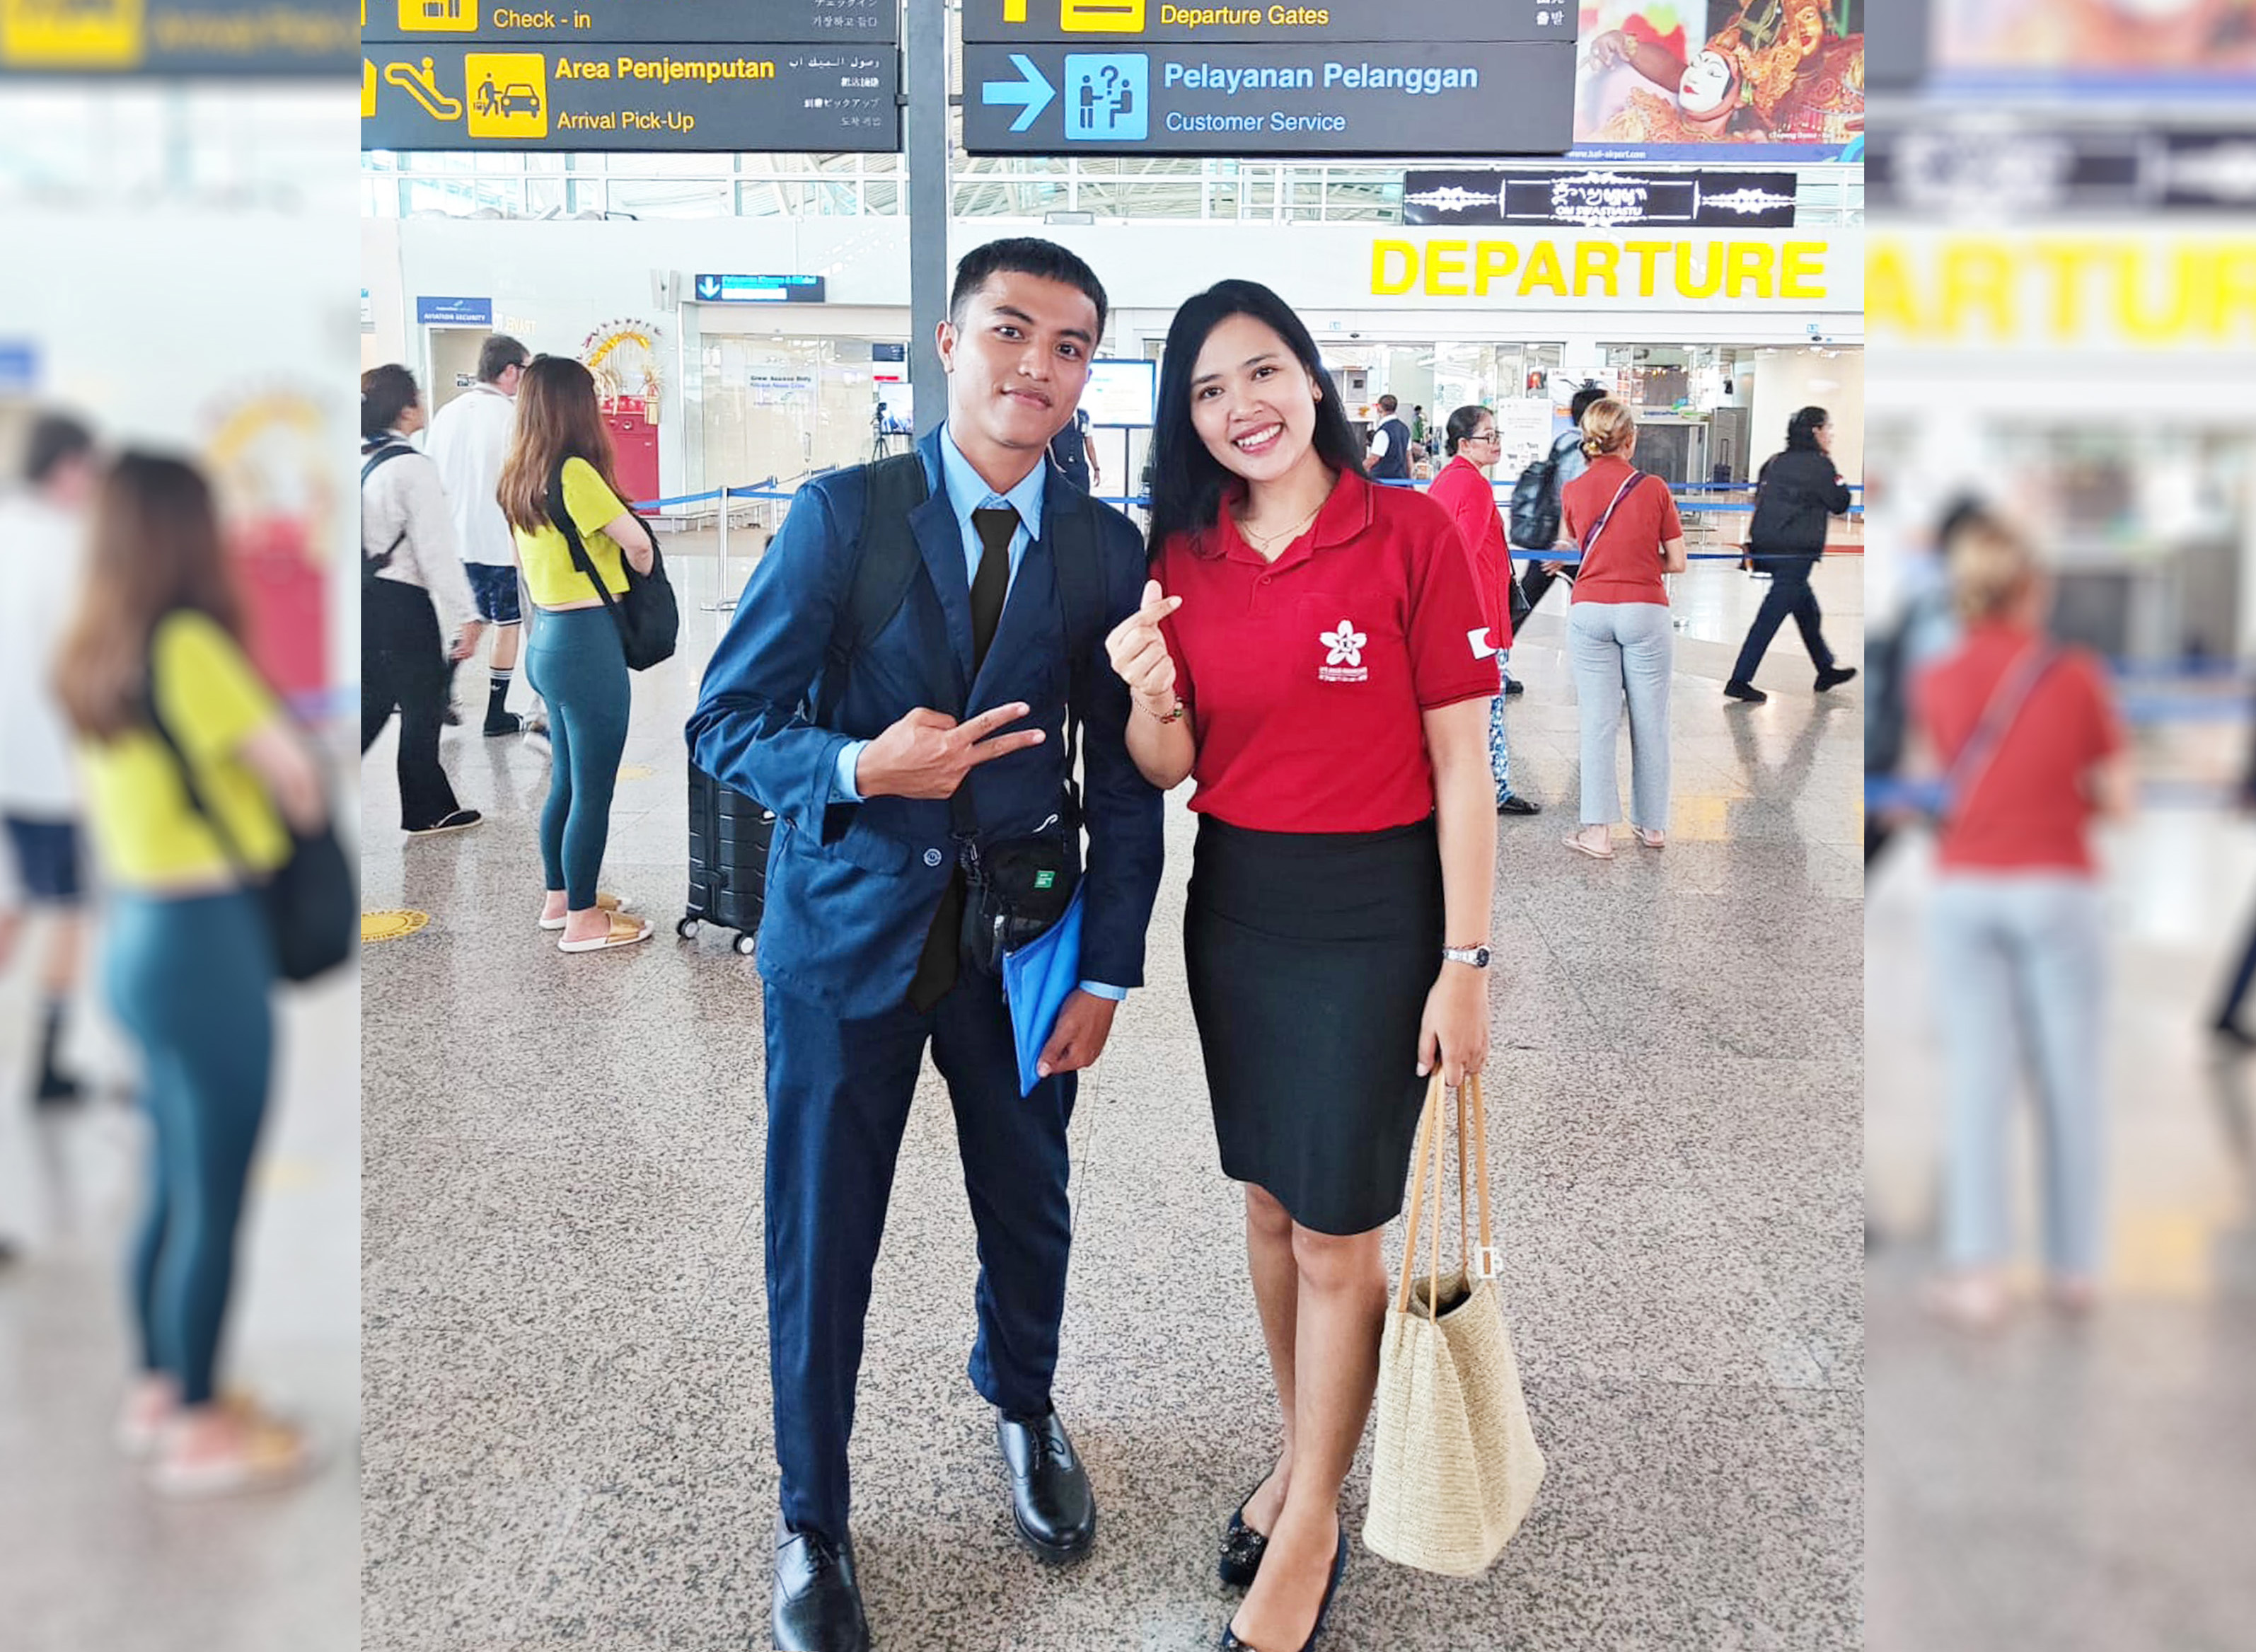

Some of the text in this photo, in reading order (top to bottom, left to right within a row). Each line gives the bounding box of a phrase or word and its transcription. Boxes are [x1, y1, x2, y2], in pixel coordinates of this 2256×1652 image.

[493, 8, 555, 28] Check
[574, 10, 591, 28] in
[1160, 4, 1329, 28] Departure Gates
[555, 57, 775, 84] Area Penjemputan
[1164, 62, 1478, 94] Pelayanan Pelanggan
[557, 111, 695, 132] Arrival Pick-Up
[1166, 112, 1346, 132] Customer Service
[1370, 239, 1828, 299] DEPARTURE
